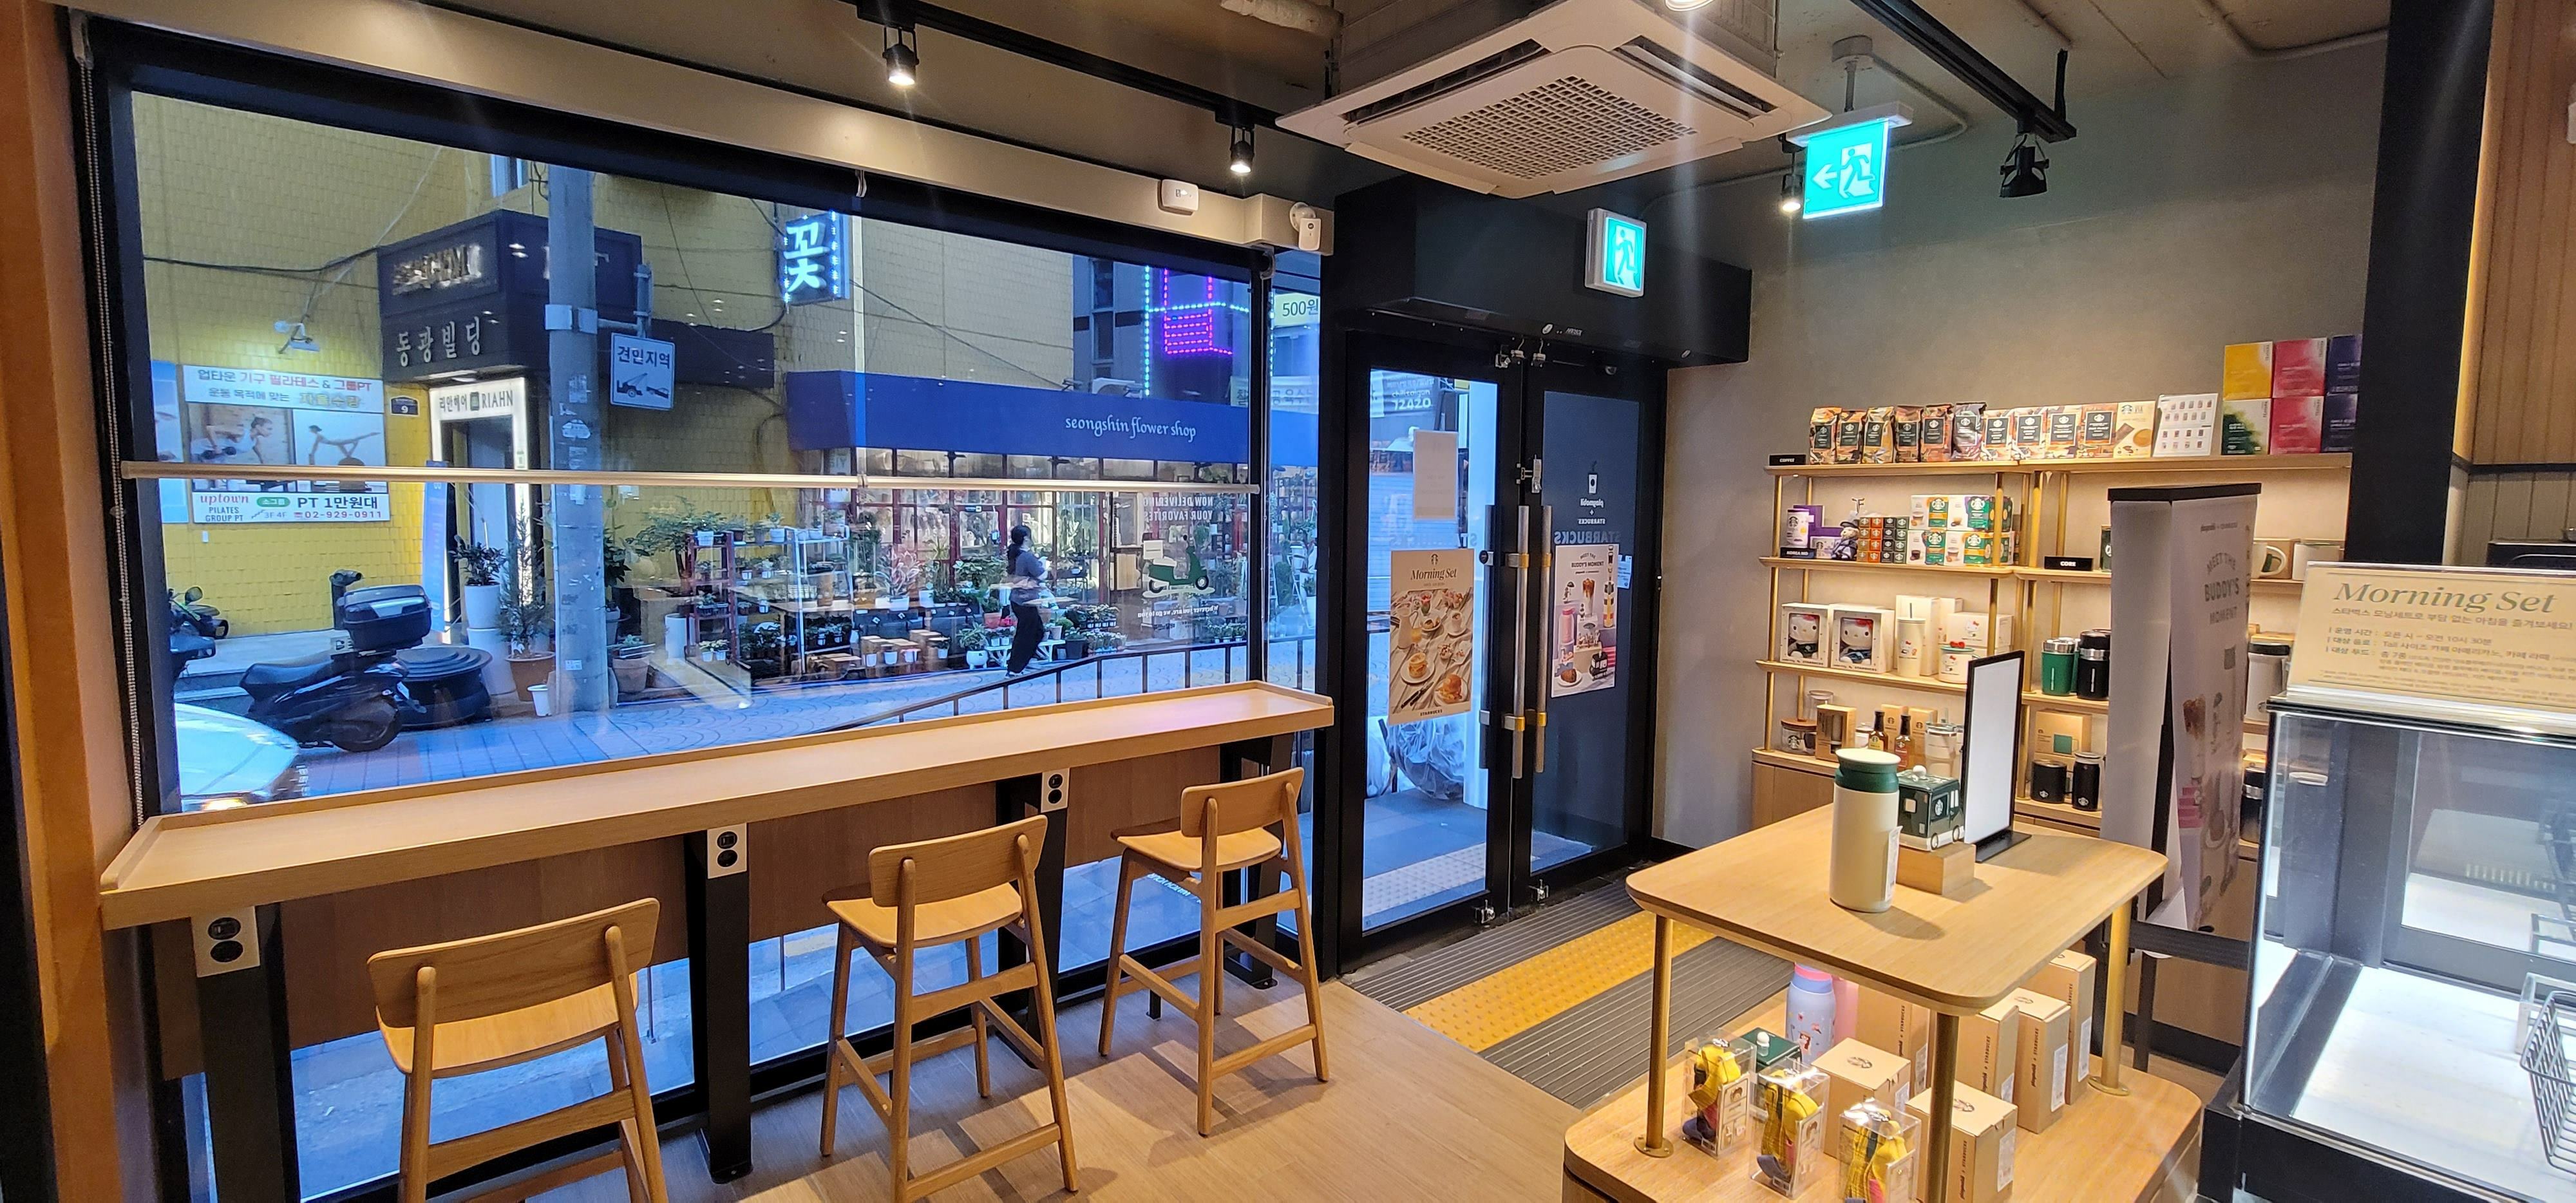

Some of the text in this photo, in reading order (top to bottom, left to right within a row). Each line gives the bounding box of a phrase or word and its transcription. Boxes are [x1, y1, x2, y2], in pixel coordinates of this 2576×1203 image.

[784, 222, 827, 292] 꽃
[1282, 298, 1318, 316] 500원
[396, 316, 480, 367] 동광빌딩
[618, 346, 670, 369] 견인지역
[198, 369, 236, 383] 업타운
[240, 372, 265, 384] 기구
[269, 374, 319, 388] 필라테스
[482, 390, 513, 408] RIAHN
[1065, 415, 1197, 442] seongshin flower shop
[200, 493, 249, 506] uptown
[298, 497, 319, 508] PT
[325, 497, 378, 509] 1만원대
[305, 511, 382, 519] 02-929-0911
[1410, 568, 1457, 580] Morning Set
[2204, 578, 2240, 602] BUDDY'S
[2332, 582, 2559, 614] Morning Set
[2332, 607, 2371, 616] 스타벅스
[2476, 616, 2508, 627] 아침을
